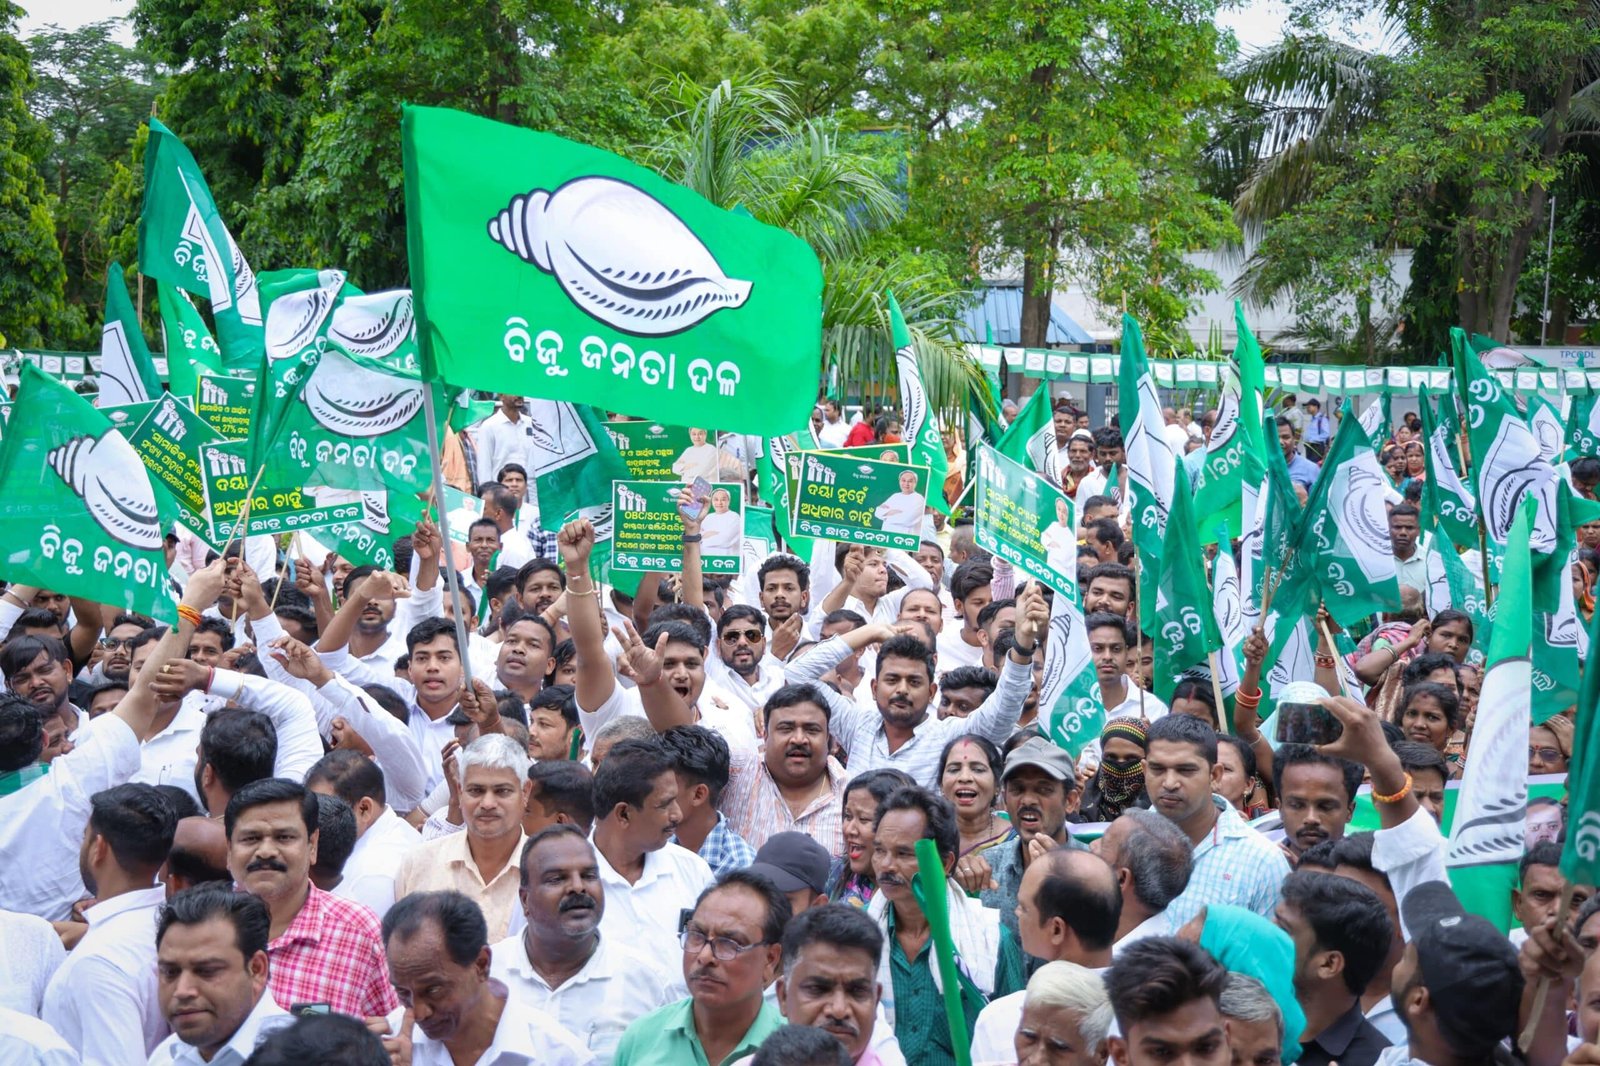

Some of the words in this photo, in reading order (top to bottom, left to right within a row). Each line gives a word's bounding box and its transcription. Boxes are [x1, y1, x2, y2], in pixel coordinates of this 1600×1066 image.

[503, 316, 569, 377] ବିଜୁ
[580, 335, 675, 390] ଜନତା
[687, 358, 741, 397] ଦଳ
[1560, 351, 1595, 359] TPCODL
[316, 440, 377, 469] ଜନତା
[383, 450, 417, 475] ଦଳ
[216, 476, 248, 492] ଦୟା
[807, 483, 834, 498] ଦୟା
[838, 486, 868, 504] ନୁହେଁ
[286, 511, 328, 526] ଜନତା
[332, 506, 359, 519] ଦଳ
[801, 503, 845, 520] ଅଧିକାର
[849, 507, 874, 527] ଚାହୁଁ
[800, 521, 822, 536] ବିଜୁ
[825, 526, 850, 539] ଛାତ୍ର
[854, 531, 889, 543] ଜନତା
[893, 536, 915, 546] ଦଳ
[40, 524, 83, 575] ବିଜୁ
[93, 545, 157, 588] ଜନତା
[617, 553, 639, 568] ବିଜୁ
[642, 557, 666, 568] ଛାତ୍ର
[712, 560, 736, 568] ଦଳ
